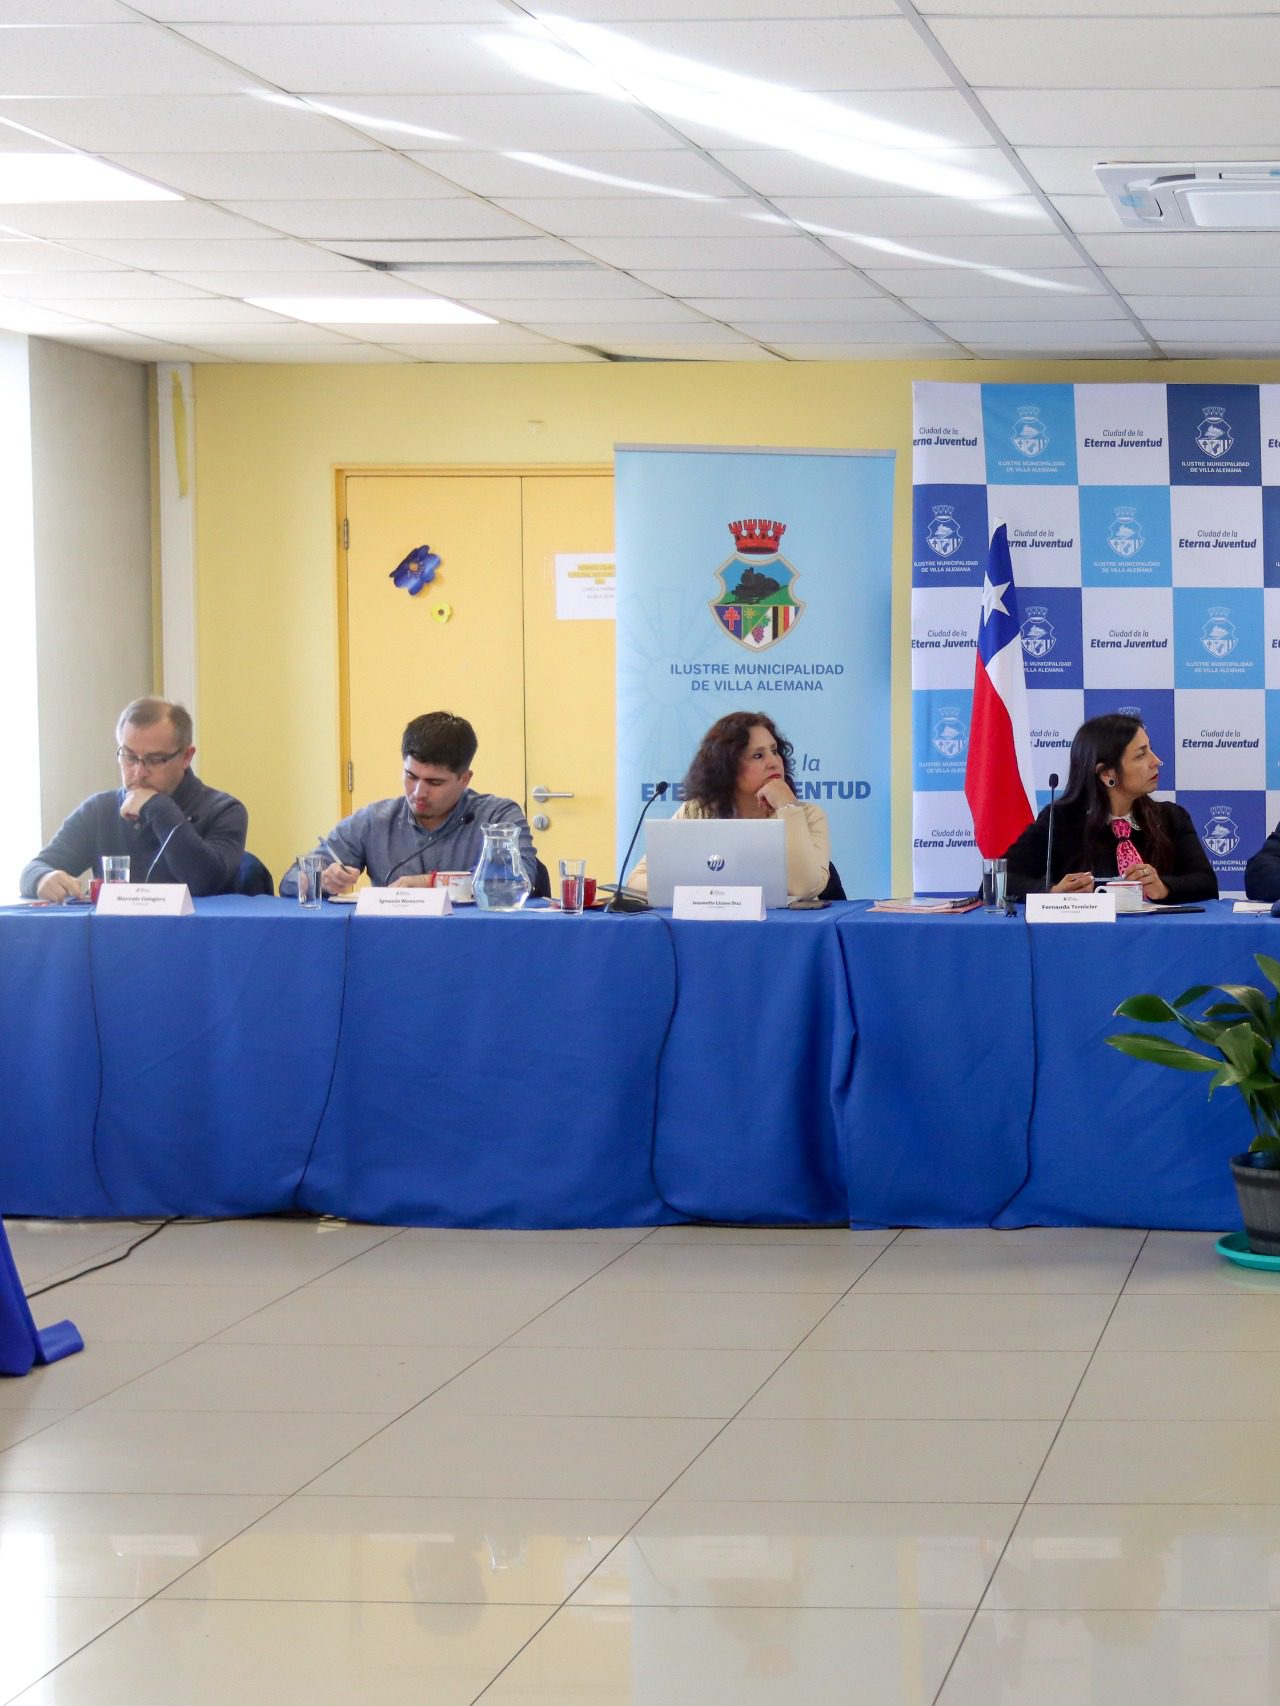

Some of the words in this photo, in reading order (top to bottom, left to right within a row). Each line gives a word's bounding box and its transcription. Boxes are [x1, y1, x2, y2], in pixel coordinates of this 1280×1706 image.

[913, 438, 932, 446] erna
[934, 436, 978, 446] Juventud
[1084, 438, 1116, 447] Eterna
[1117, 438, 1162, 448] Juventud
[1028, 538, 1073, 548] Juventud
[1179, 538, 1210, 548] Eterna
[1211, 538, 1256, 548] Juventud
[941, 639, 978, 648] Juventu
[1090, 638, 1122, 648] Eterna
[1122, 638, 1168, 648] Juventud
[670, 663, 729, 675] ILUSTRE
[734, 663, 844, 675] MUNICIPALIDAD
[691, 680, 710, 691] DE
[714, 680, 753, 691] VILLA
[757, 680, 823, 691] ALEMANA
[1034, 739, 1072, 748] Juventu
[1182, 738, 1214, 748] Eterna
[1214, 738, 1259, 748] Juventud
[802, 753, 820, 771] la
[794, 781, 872, 800] ENTUD
[914, 839, 944, 848] Eterna
[946, 838, 976, 847] Juvent
[707, 854, 725, 872] hp
